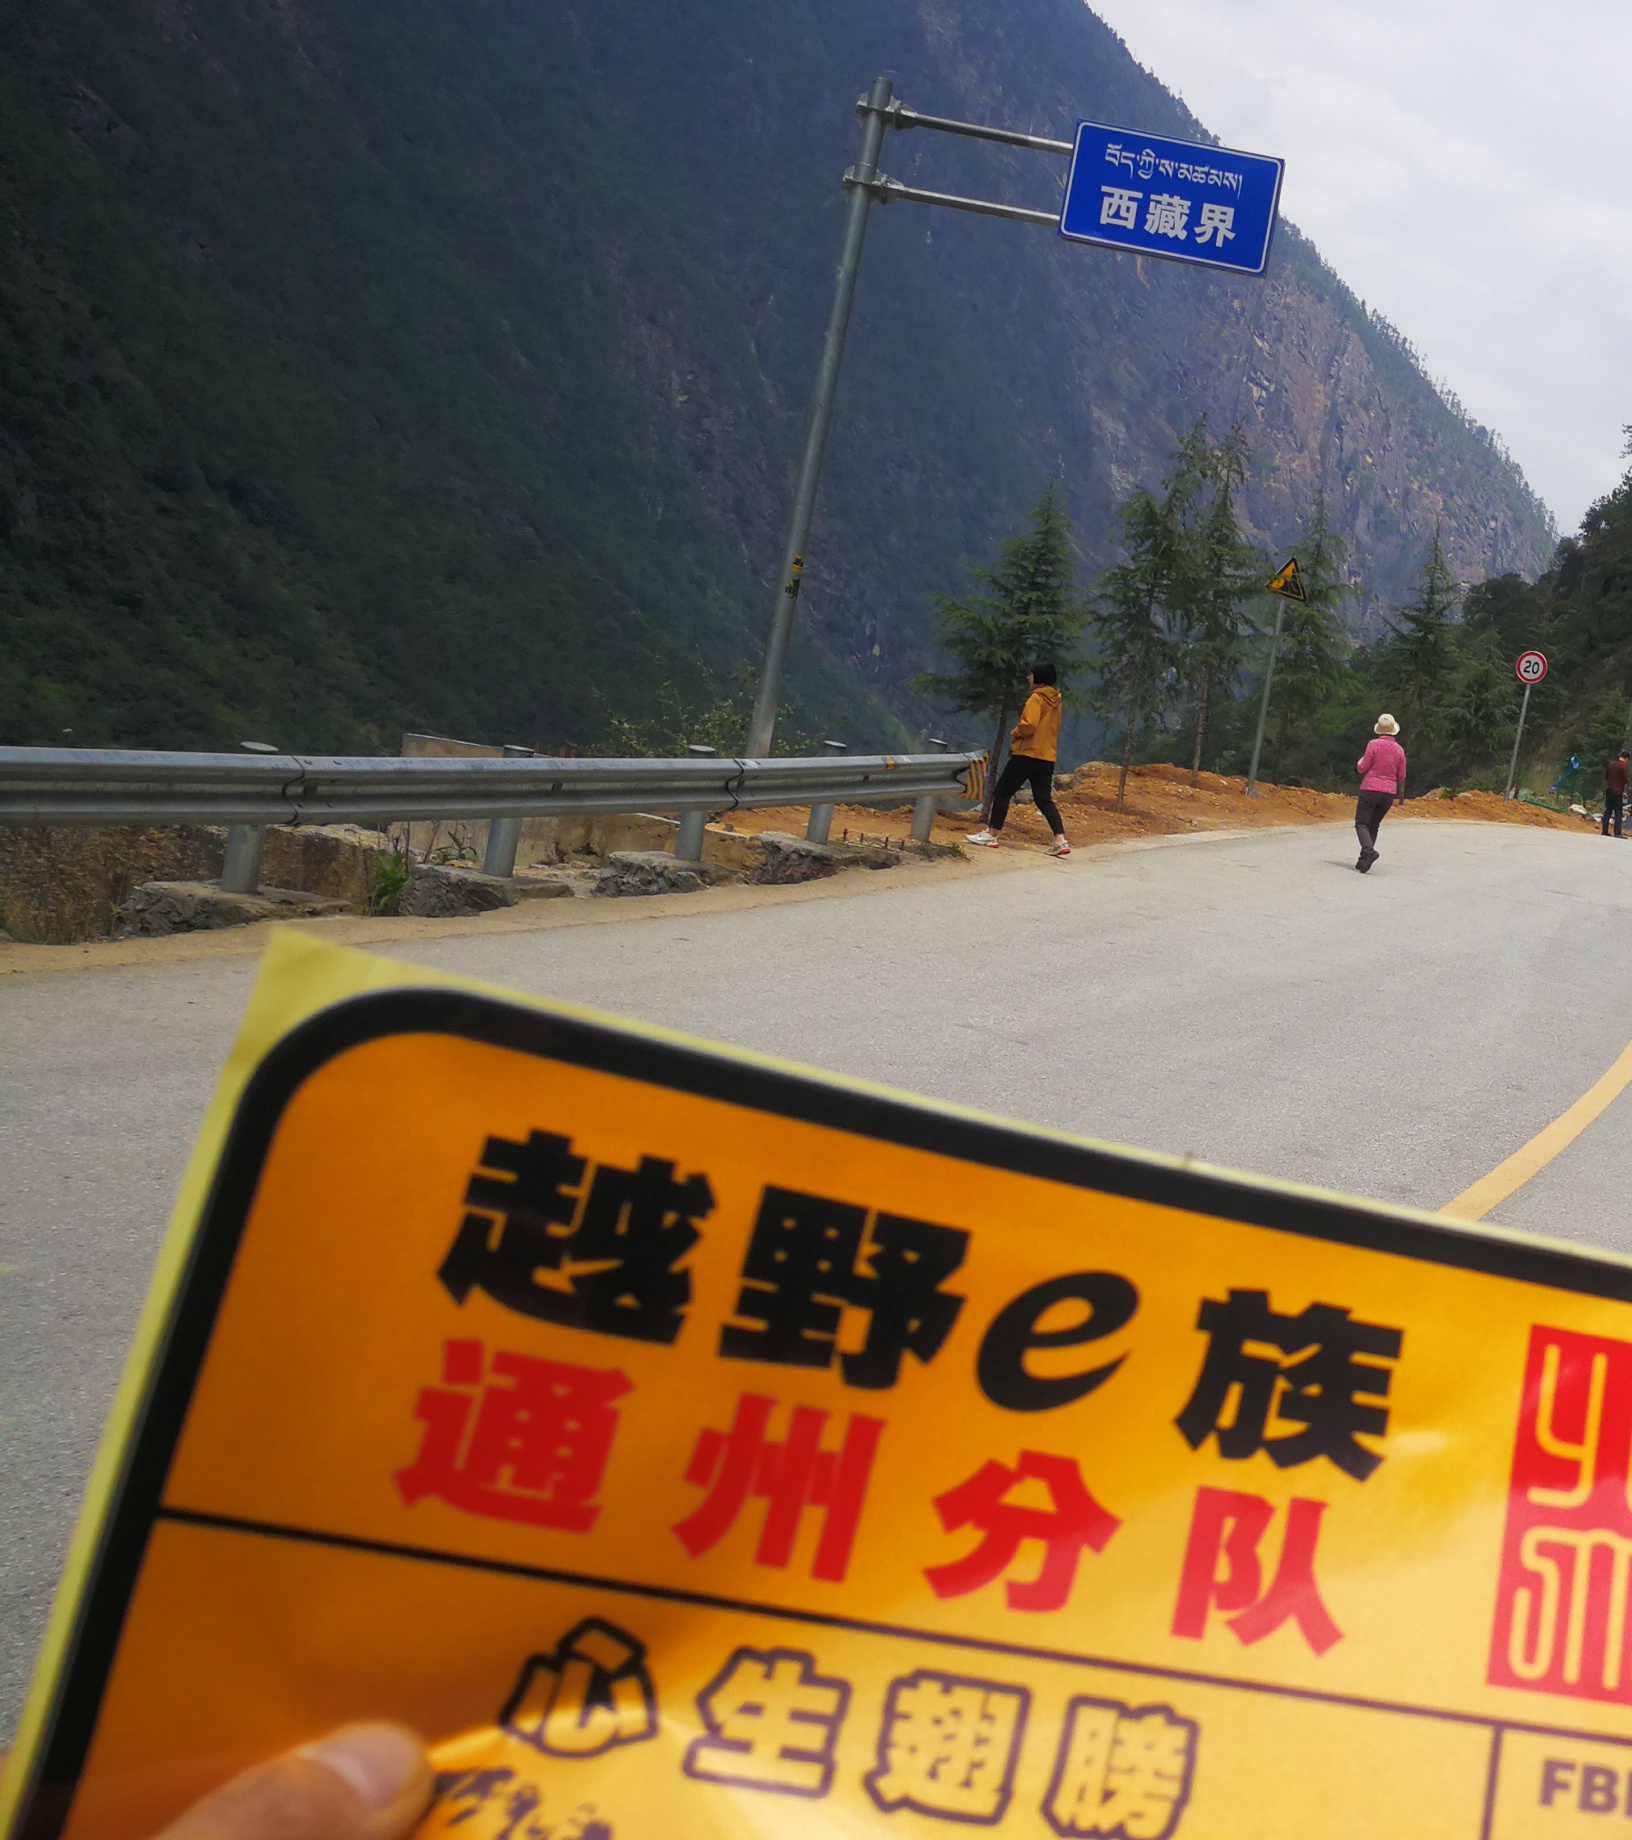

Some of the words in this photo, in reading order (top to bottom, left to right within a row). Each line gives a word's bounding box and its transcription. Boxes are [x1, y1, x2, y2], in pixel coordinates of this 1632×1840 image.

[1100, 185, 1236, 248] 西藏界
[1524, 660, 1540, 675] 20
[436, 1128, 1404, 1481] 越野e族
[391, 1338, 1344, 1656] 通州分队
[499, 1616, 1200, 1840] 心生翅膀
